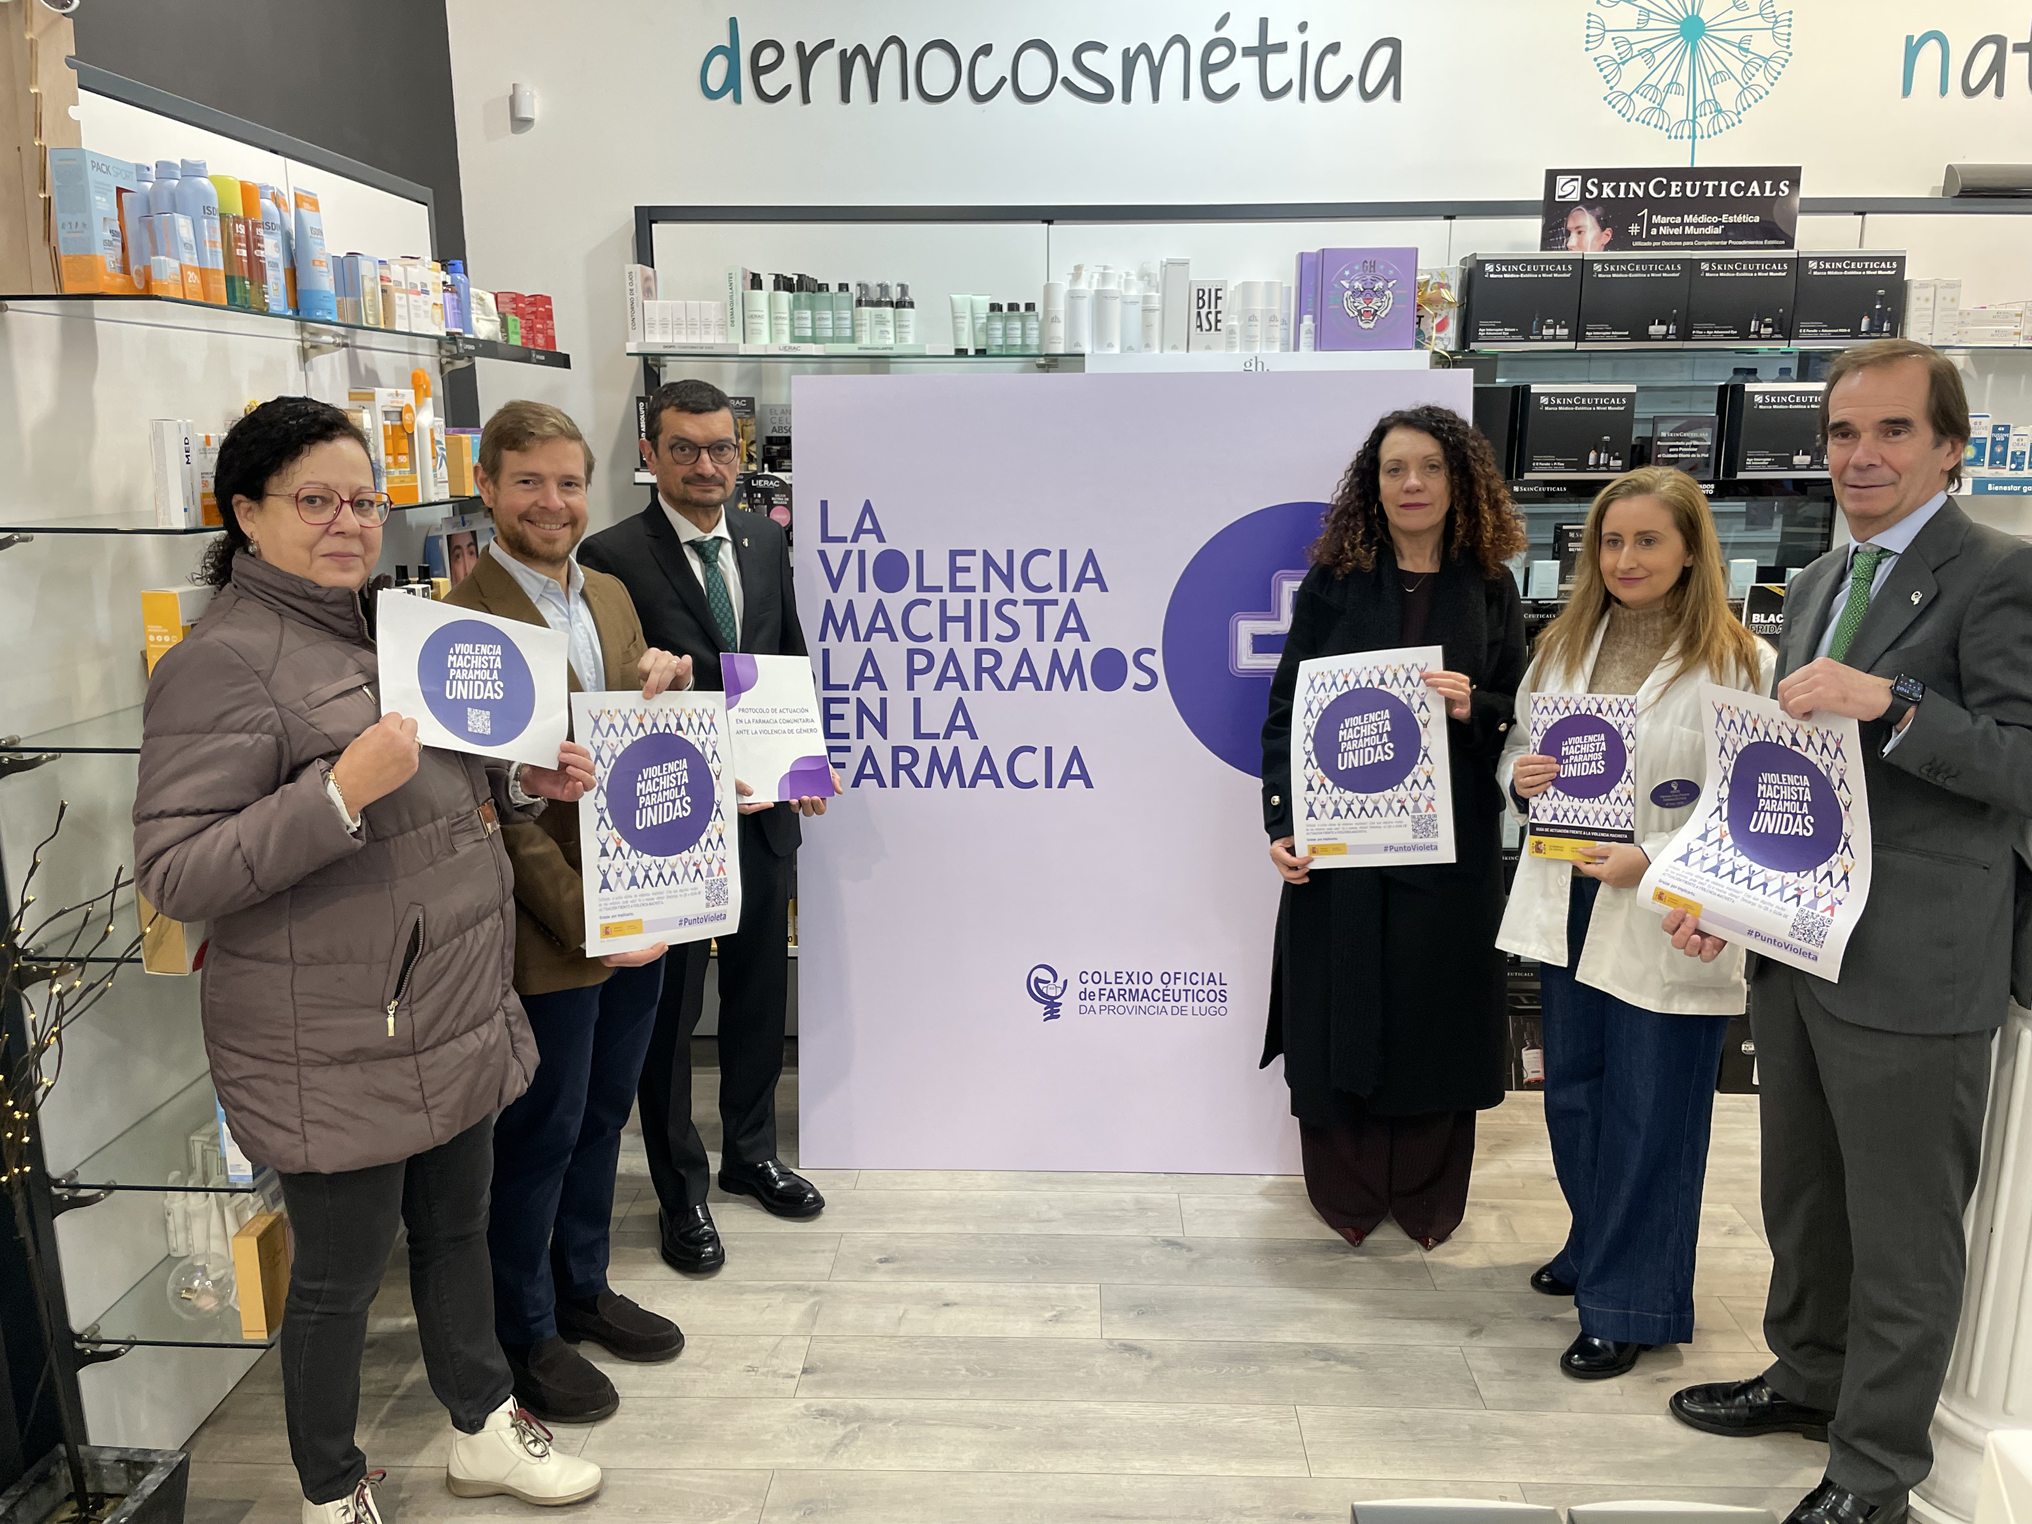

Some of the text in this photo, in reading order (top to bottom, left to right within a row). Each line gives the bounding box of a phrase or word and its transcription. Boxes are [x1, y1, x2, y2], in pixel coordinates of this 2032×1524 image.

[700, 13, 1402, 106] dermocosmética
[91, 159, 111, 176] PACK
[1585, 177, 1790, 200] SKINCEUTICALS
[1652, 212, 1760, 224] Marca Médico-Estética
[1659, 226, 1679, 236] Nivel
[1362, 260, 1376, 273] GH
[629, 287, 635, 295] DE
[1196, 288, 1222, 310] BIF
[627, 296, 637, 330] CONTORNO
[1195, 310, 1222, 332] ASE
[1550, 396, 1627, 405] SKINCEUTICALS
[201, 480, 209, 488] 50
[752, 479, 780, 487] LIERAC
[1987, 483, 2021, 491] Bienestar
[820, 499, 887, 544] LA
[816, 548, 1109, 594] VIOLENCIA
[818, 598, 1091, 643] MACHISTA
[454, 643, 502, 656] VIOLENCIA
[447, 654, 502, 670] MACHISTA
[822, 647, 1159, 693] LA PARAMOS
[445, 680, 504, 700] UNIDAS
[823, 697, 979, 741] EN LA
[1344, 708, 1390, 728] VIOLENCIA
[1338, 720, 1392, 742] MACHISTA
[1568, 733, 1605, 745] VIOLENCIA
[1337, 742, 1395, 771] UNIDAS
[1561, 741, 1606, 757] MACHISTA
[1569, 752, 1603, 763] PARAMOS
[642, 758, 688, 780] VIOLENCIA
[1559, 760, 1605, 778] UNIDAS
[636, 769, 689, 797] MACHISTA
[1761, 772, 1810, 787] VIOLENCIA
[1757, 784, 1812, 802] MACHISTA
[635, 796, 692, 830] UNIDAS
[1749, 813, 1815, 837] UNIDAS
[1383, 843, 1438, 853] #PuntoVioleta
[678, 912, 727, 928] #PuntoVioleta
[1747, 928, 1819, 962] #PuntoVioleta
[1079, 970, 1227, 986] COLEXIO OFICIAL
[1078, 986, 1227, 1003] de FARMACÉUTICOS
[1078, 1004, 1228, 1017] DA PROVINCIA DE LUGO
